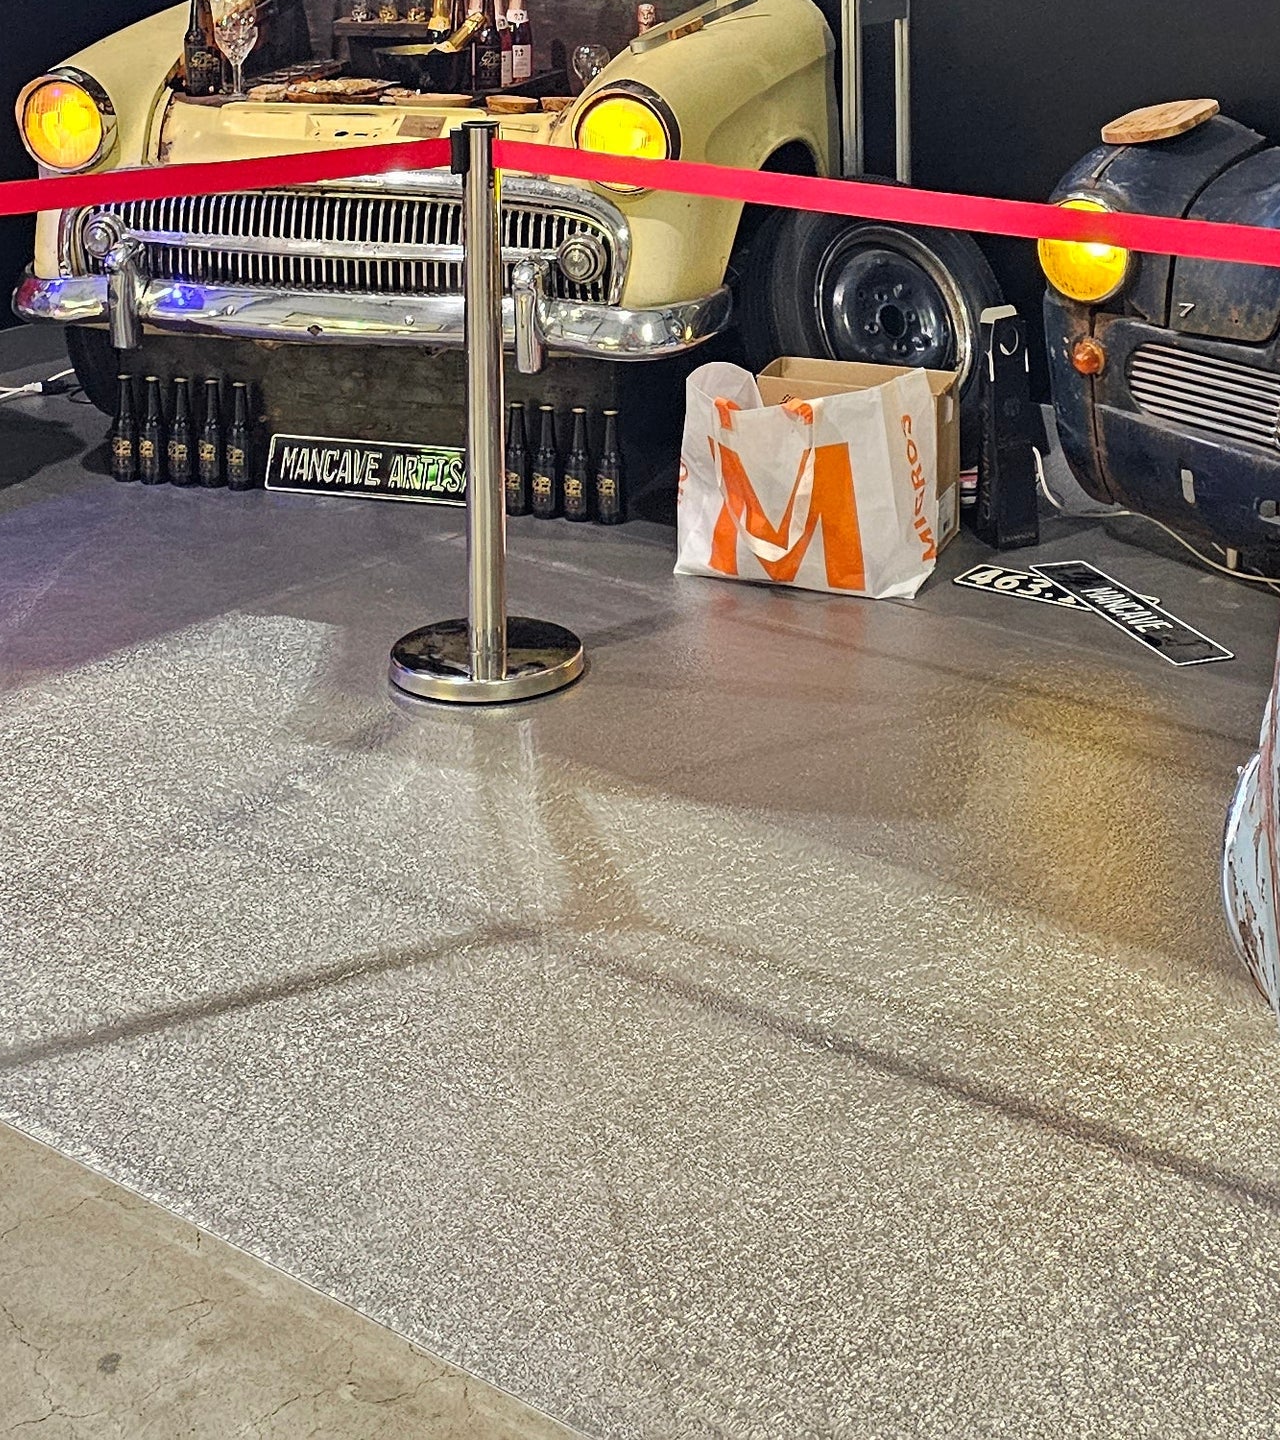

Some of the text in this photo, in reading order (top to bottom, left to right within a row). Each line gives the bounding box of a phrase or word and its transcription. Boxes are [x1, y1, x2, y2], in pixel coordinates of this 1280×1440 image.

[279, 445, 383, 487] MANCAVE
[387, 453, 468, 494] ARTIS
[1079, 586, 1174, 634] MANCAVE
